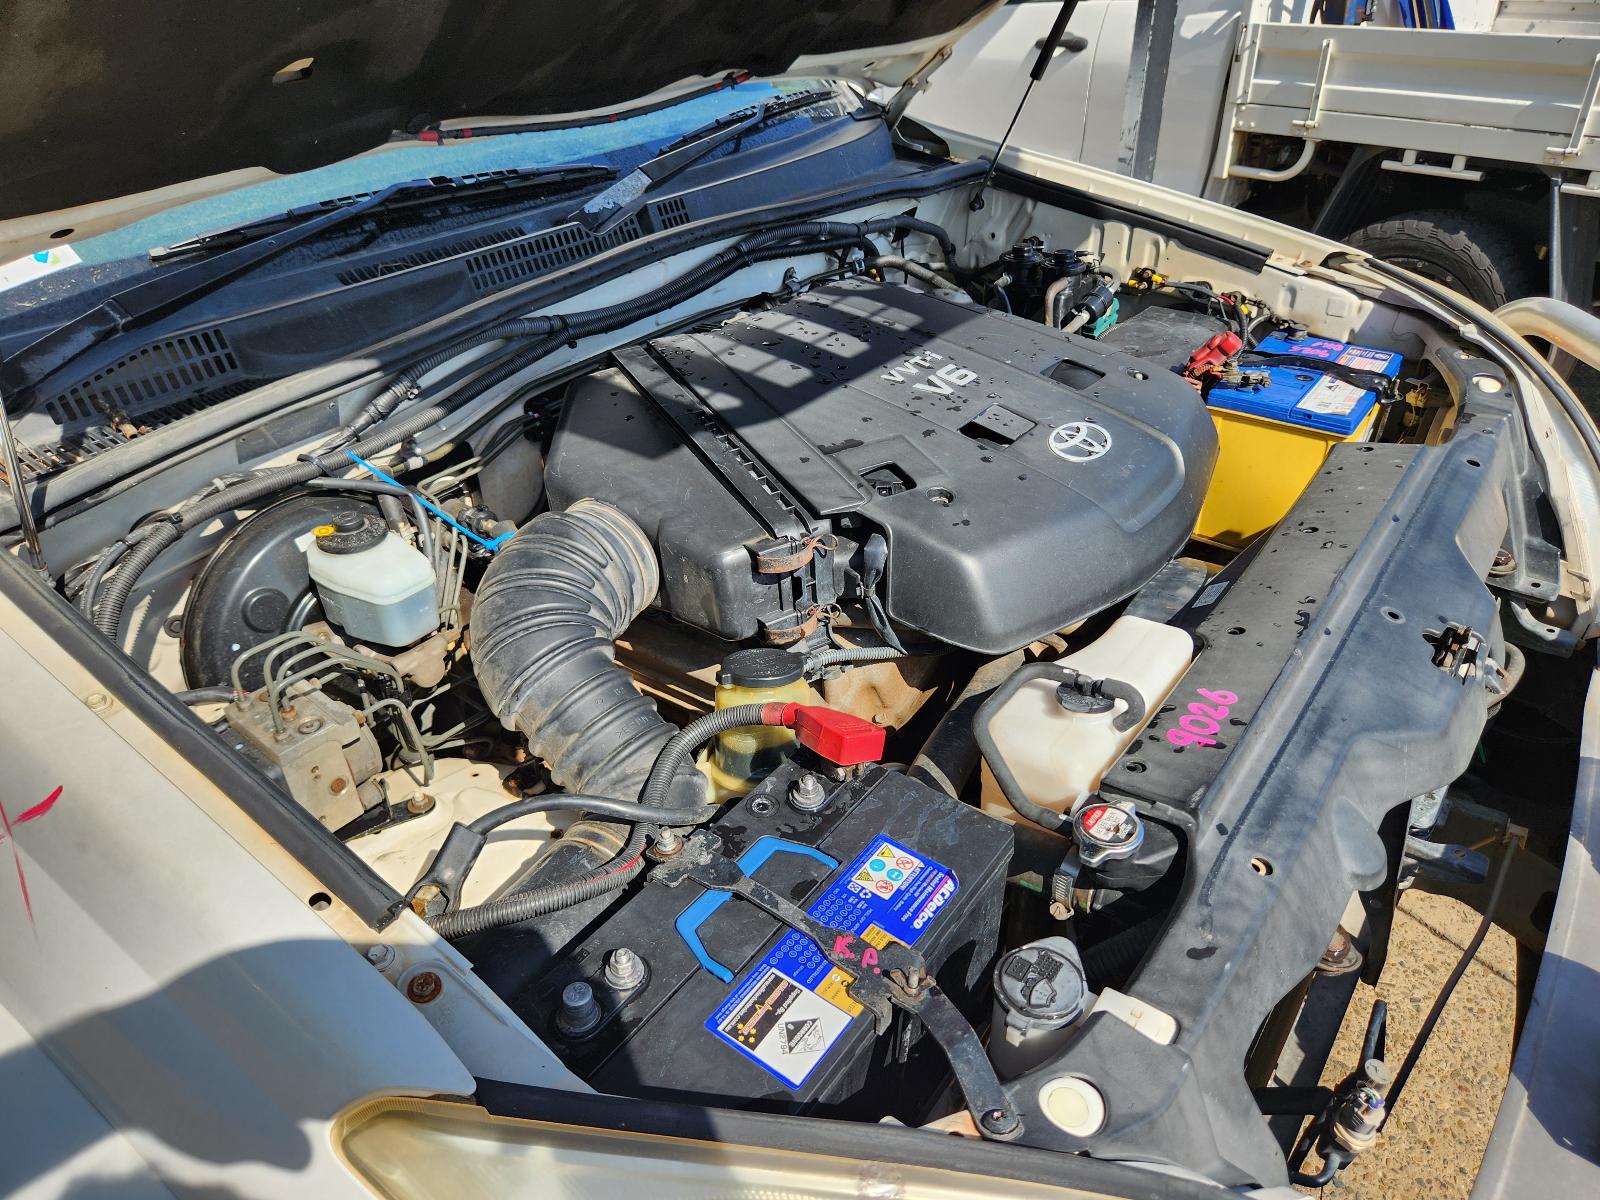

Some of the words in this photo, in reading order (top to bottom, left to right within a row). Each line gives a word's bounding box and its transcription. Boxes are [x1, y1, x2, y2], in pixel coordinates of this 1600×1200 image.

[880, 350, 943, 382] VVT-i
[912, 363, 978, 395] V6
[1167, 687, 1239, 747] 9026
[929, 871, 945, 887] Sealed
[907, 884, 933, 913] Maintenance
[913, 878, 956, 930] ACDelco
[900, 909, 913, 922] Free
[781, 988, 801, 1008] Supplied
[777, 1023, 789, 1055] UN2794
[788, 1019, 813, 1048] CORROSIVE
